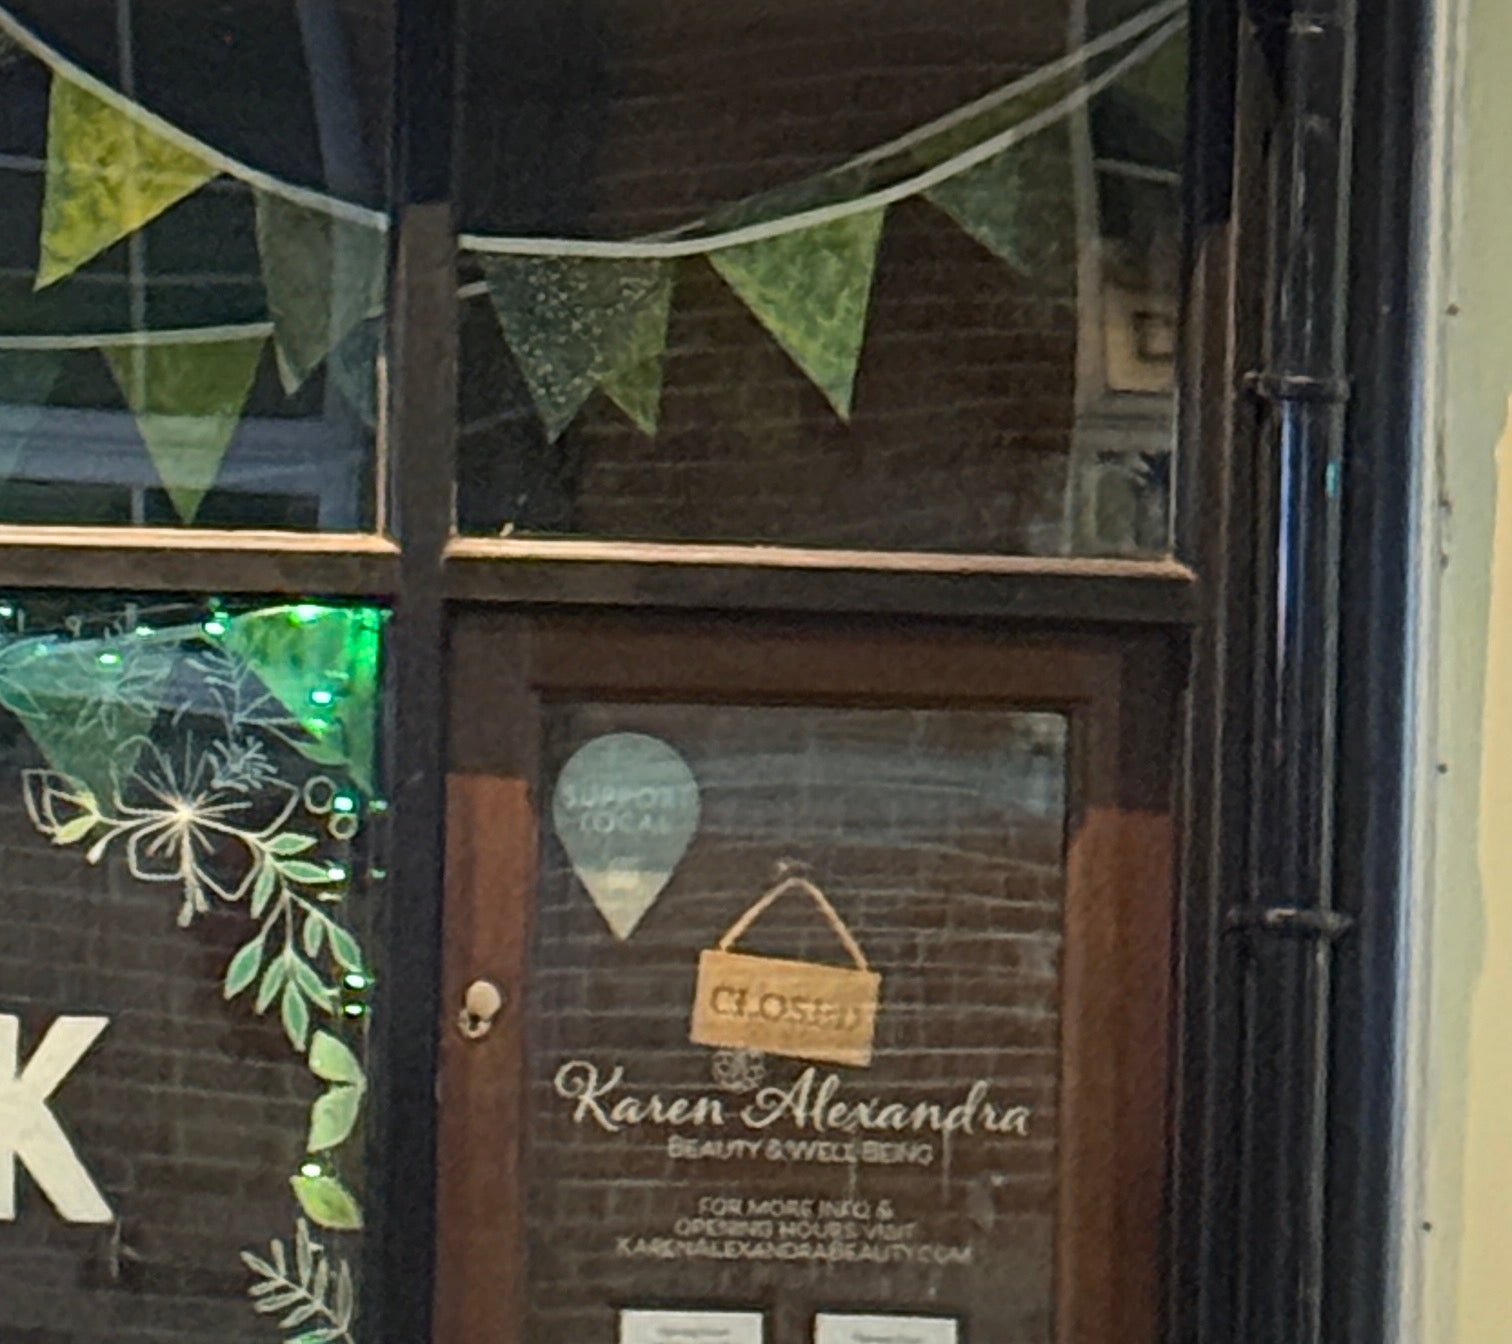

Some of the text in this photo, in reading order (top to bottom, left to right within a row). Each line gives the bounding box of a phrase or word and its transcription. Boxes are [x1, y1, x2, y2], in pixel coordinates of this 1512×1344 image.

[554, 1060, 1030, 1136] Karen Alexandra
[667, 1134, 763, 1160] BEAUTY
[698, 1196, 742, 1216] FOR
[747, 1198, 814, 1218] MORE
